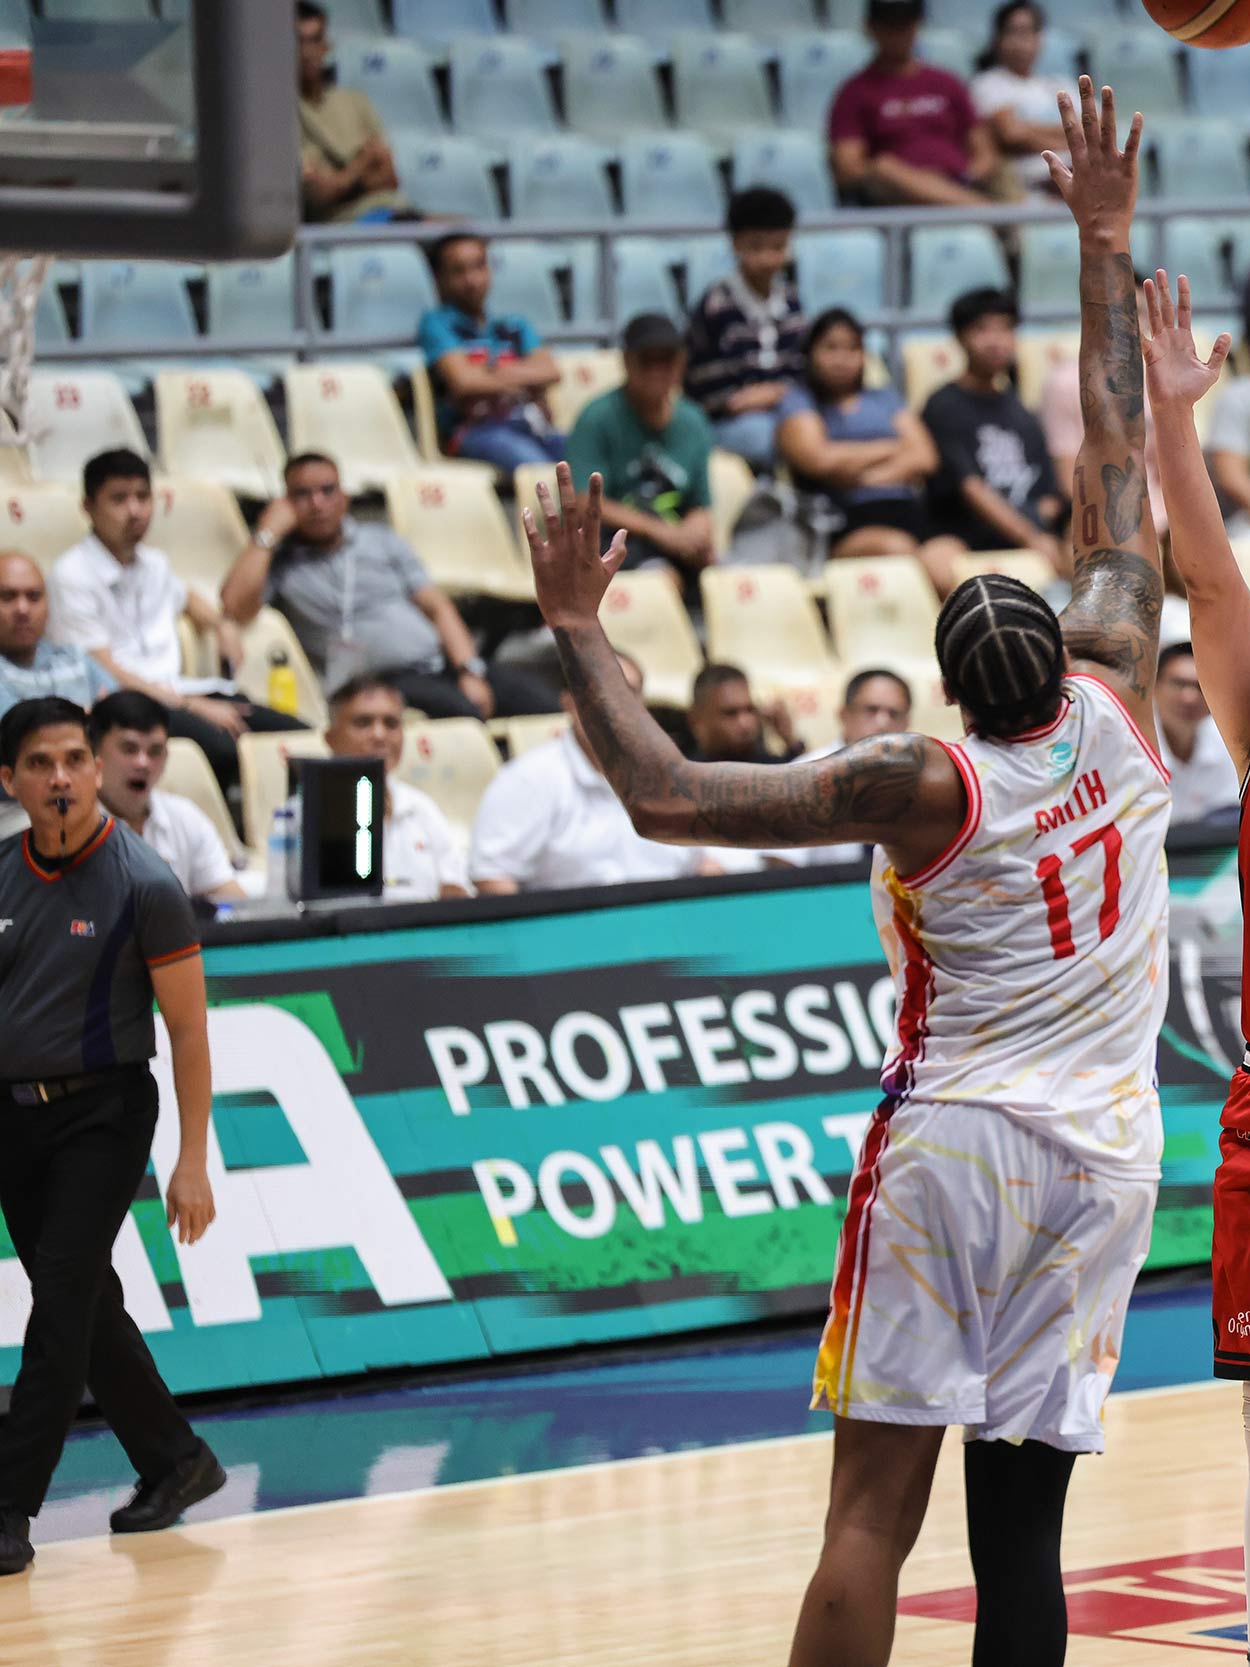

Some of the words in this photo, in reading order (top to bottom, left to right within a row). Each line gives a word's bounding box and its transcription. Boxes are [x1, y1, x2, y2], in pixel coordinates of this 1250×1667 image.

[355, 775, 373, 879] 1
[1035, 821, 1123, 960] 17
[472, 1121, 836, 1246] POWER
